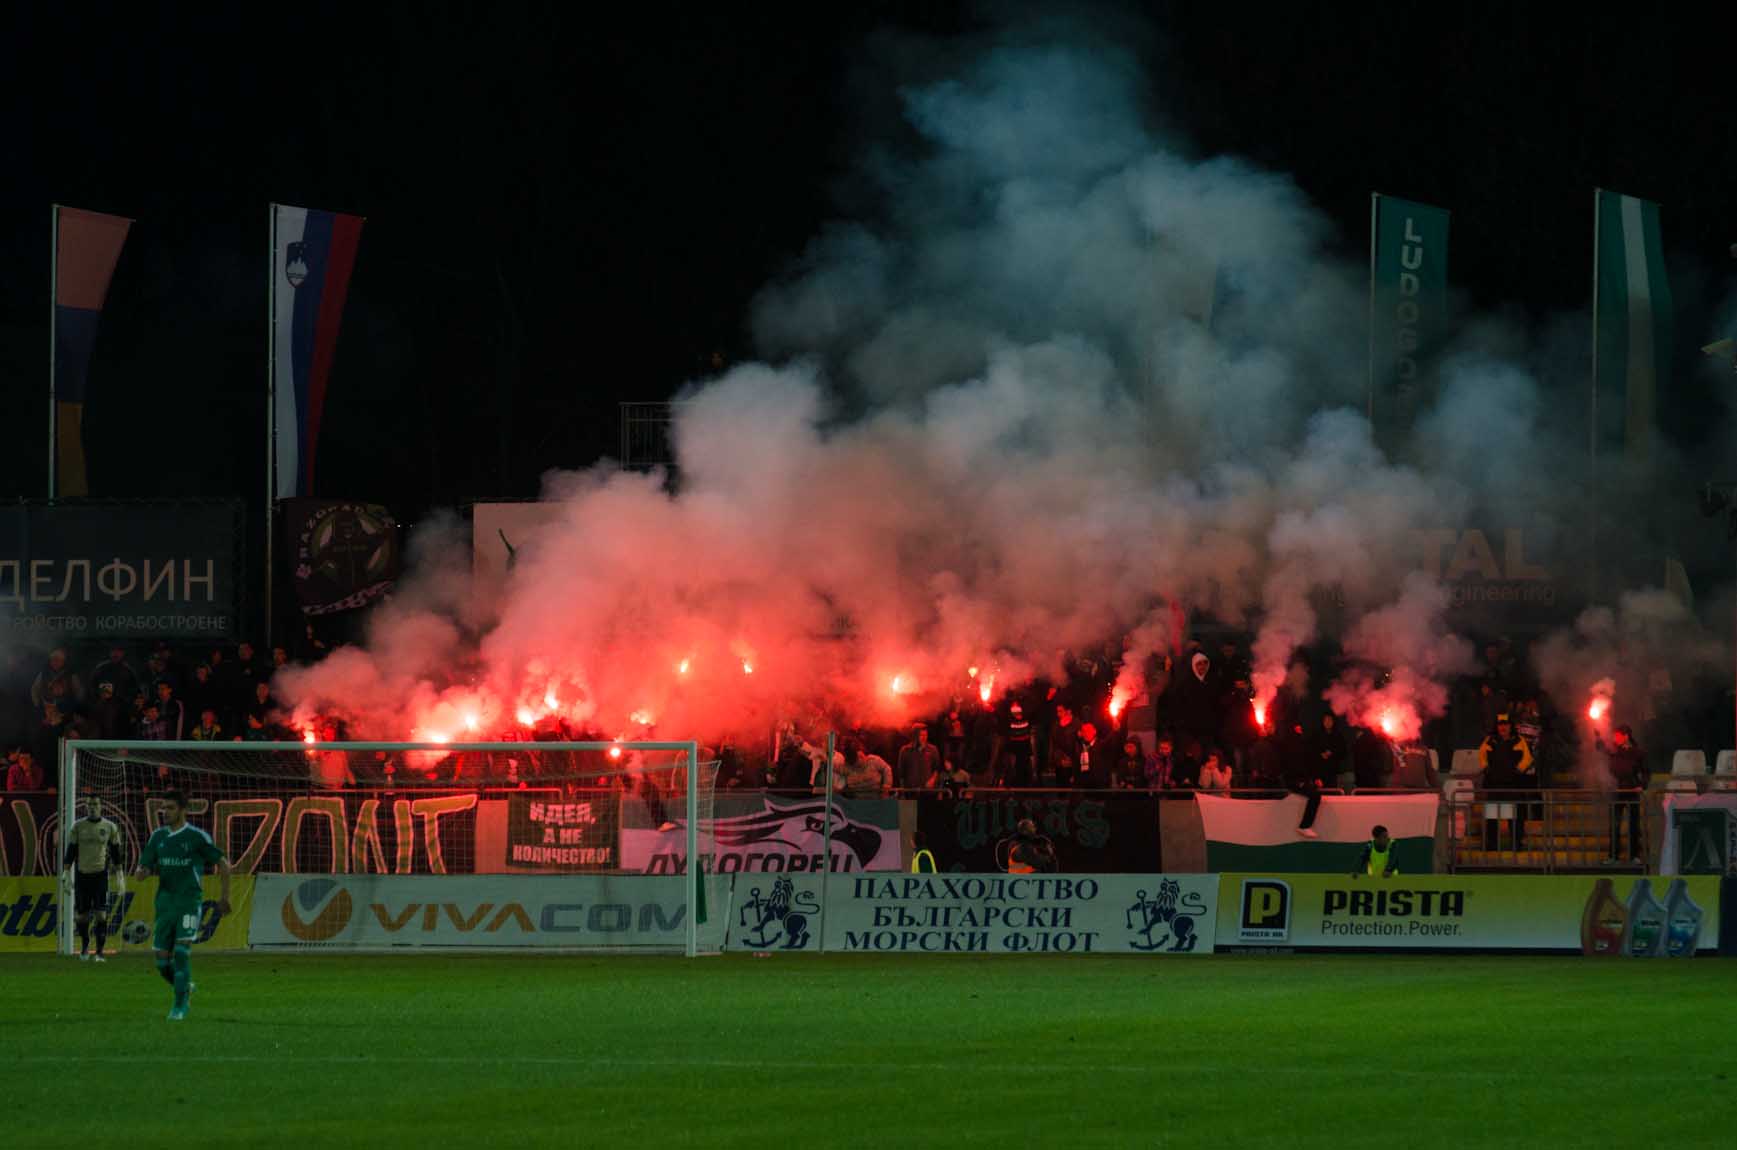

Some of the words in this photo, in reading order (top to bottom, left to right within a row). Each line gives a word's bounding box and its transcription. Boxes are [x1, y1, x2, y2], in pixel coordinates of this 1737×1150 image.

[0, 557, 214, 612] ДЕЛФИН
[560, 828, 584, 844] НЕ
[853, 877, 1099, 901] ПАРАХОДСТВО
[1323, 890, 1464, 916] PRISTA
[370, 903, 687, 932] VIVACOM
[873, 906, 1072, 928] БЪЛГАРСКИ
[845, 931, 987, 952] МОРСКИ
[1003, 931, 1099, 952] ФЛОТ
